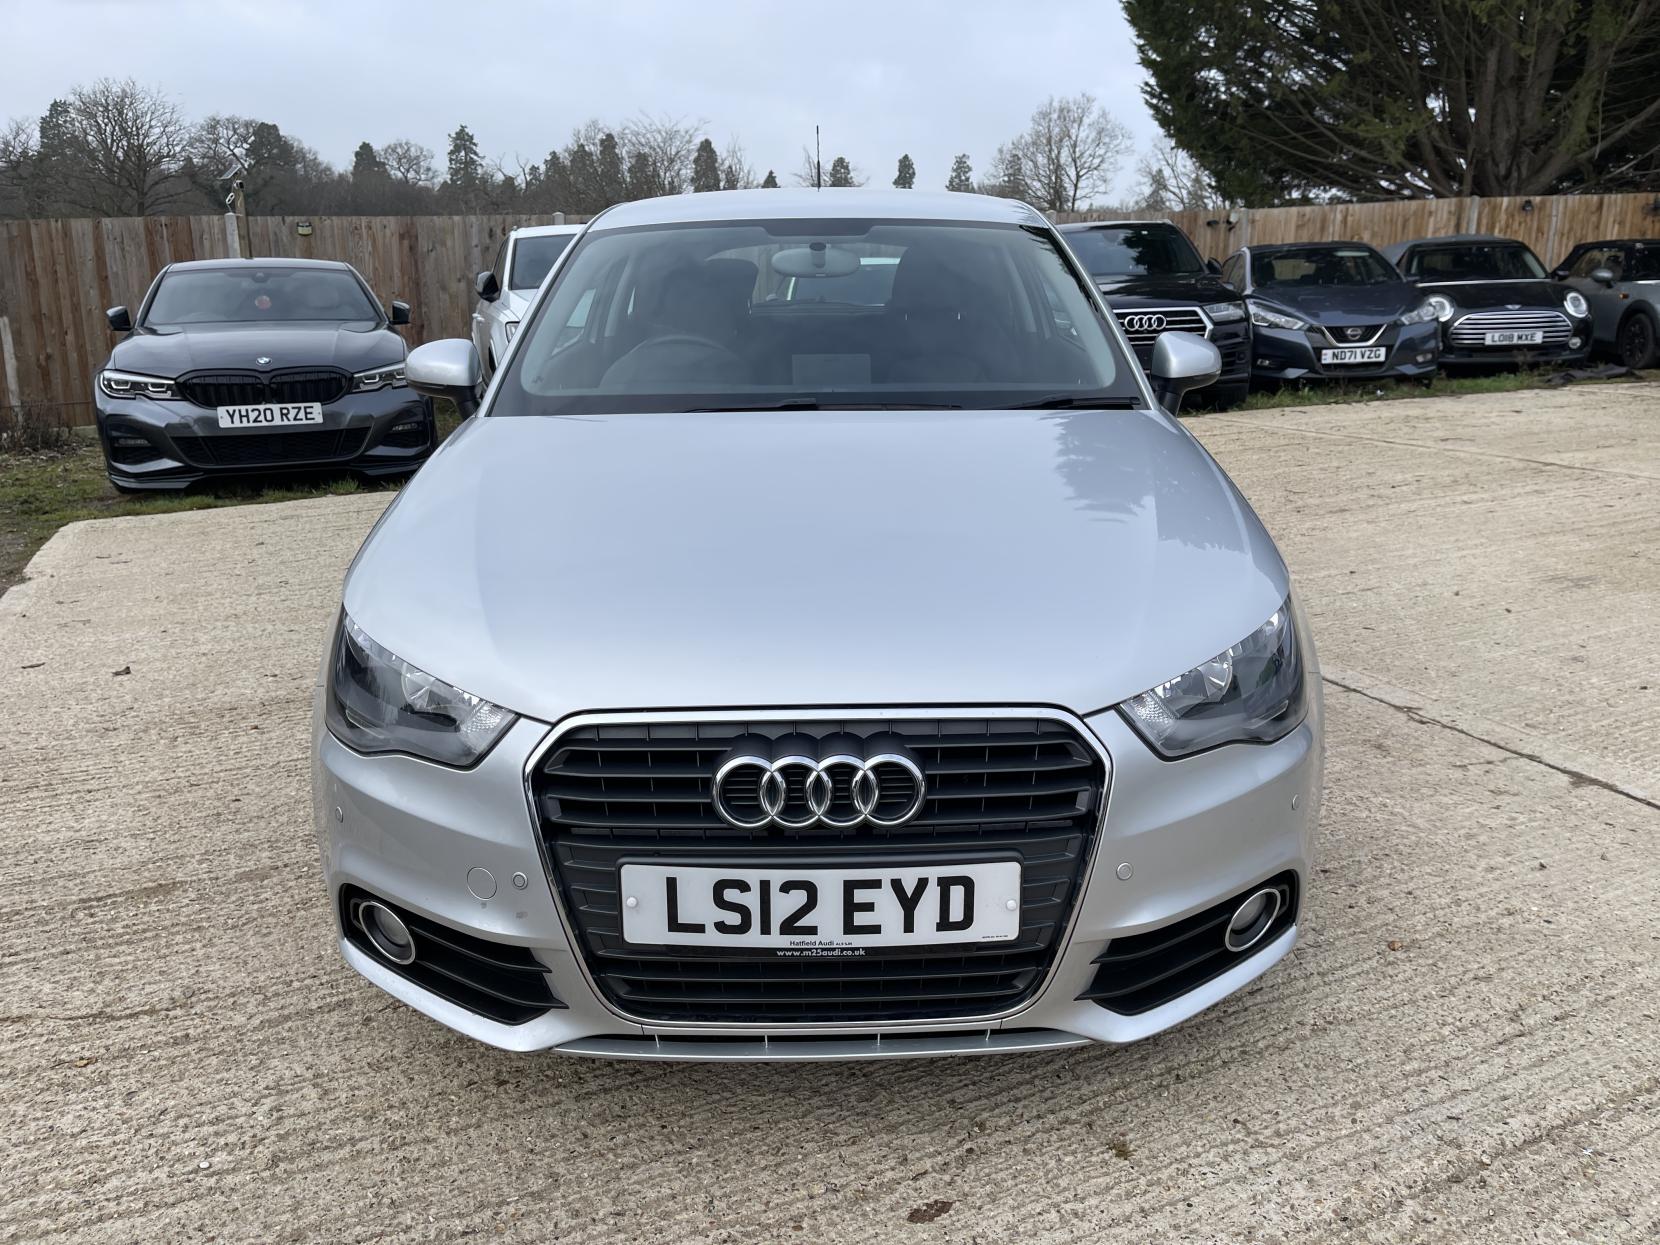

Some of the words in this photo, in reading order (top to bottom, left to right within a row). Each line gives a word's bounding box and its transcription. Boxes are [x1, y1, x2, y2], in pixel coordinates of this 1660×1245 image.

[1332, 350, 1357, 361] ND71
[1360, 348, 1381, 360] VZG
[226, 408, 275, 425] YH20
[279, 406, 315, 422] RZE
[666, 876, 818, 936] LS12
[843, 875, 975, 935] EYD
[776, 948, 866, 957] www.m25audi.co.uk
